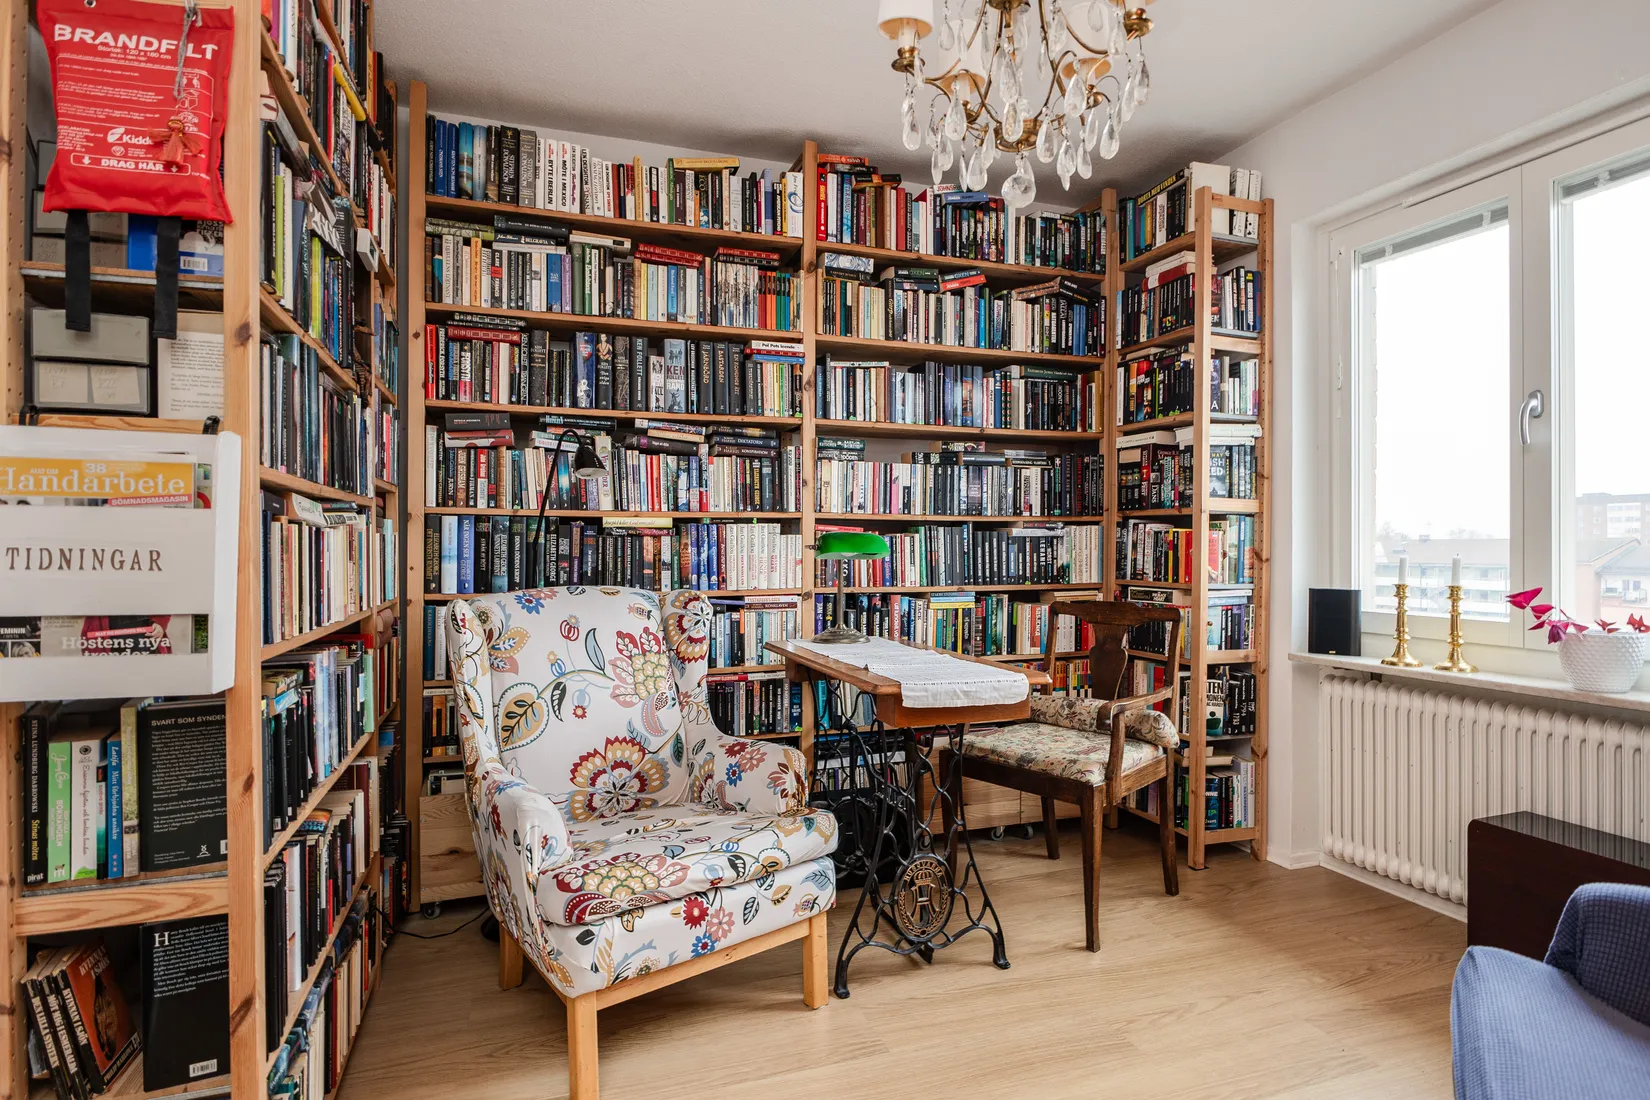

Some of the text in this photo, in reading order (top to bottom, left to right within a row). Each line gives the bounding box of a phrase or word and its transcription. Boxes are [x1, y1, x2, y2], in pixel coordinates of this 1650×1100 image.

[54, 23, 218, 60] BRANDFLT
[101, 158, 136, 169] DRAG
[666, 365, 685, 375] KEN
[86, 462, 106, 474] 38
[112, 496, 189, 505] SÖMNADSMAGASIN
[6, 547, 163, 572] TIDNINGAR
[62, 636, 171, 652] Höstens nya
[111, 746, 119, 766] Latifa
[111, 786, 119, 816] förbjudna
[32, 820, 40, 860] Stinas möten
[27, 873, 44, 883] pirat
